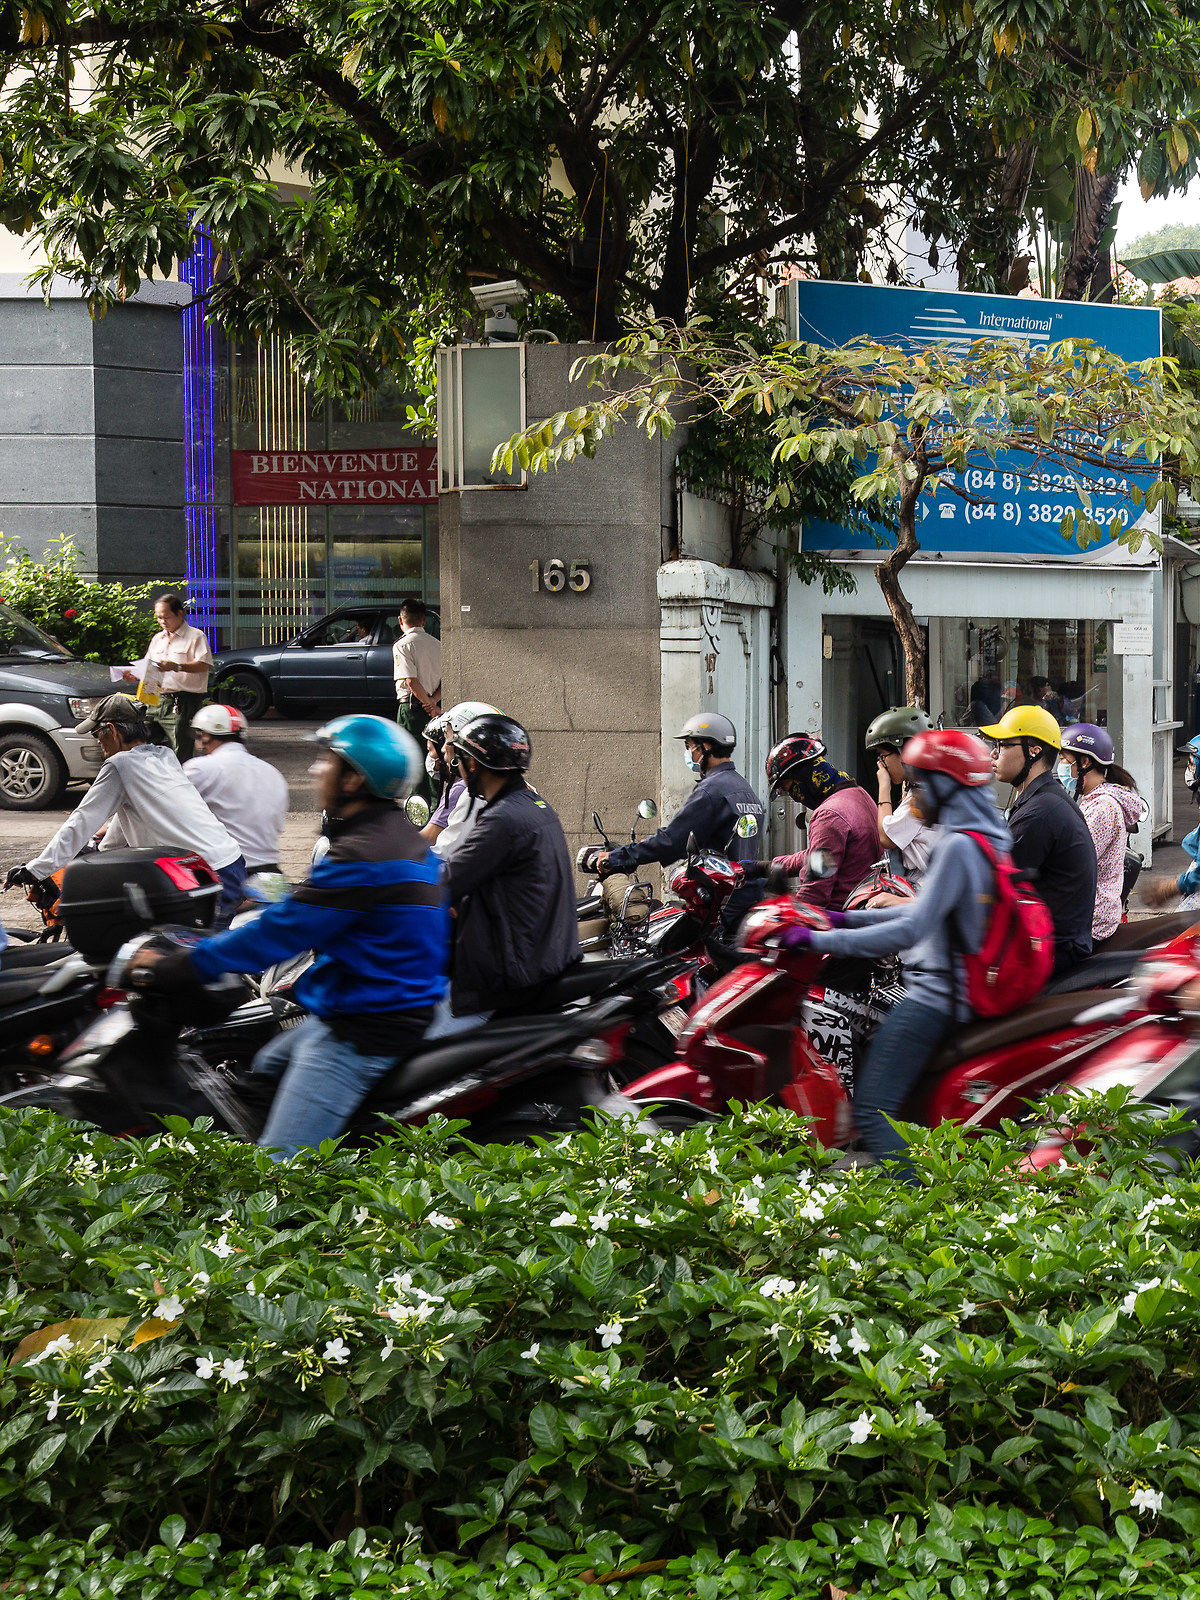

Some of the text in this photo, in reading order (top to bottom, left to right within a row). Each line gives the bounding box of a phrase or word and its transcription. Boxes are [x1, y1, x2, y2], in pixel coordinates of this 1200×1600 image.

[979, 310, 1053, 332] International
[250, 452, 419, 474] BIENVENUE
[964, 469, 996, 495] (84
[1002, 470, 1021, 495] 8)
[1028, 473, 1076, 493] 3829
[964, 501, 997, 525] (84
[1002, 502, 1021, 526] 8)
[529, 558, 591, 592] 165
